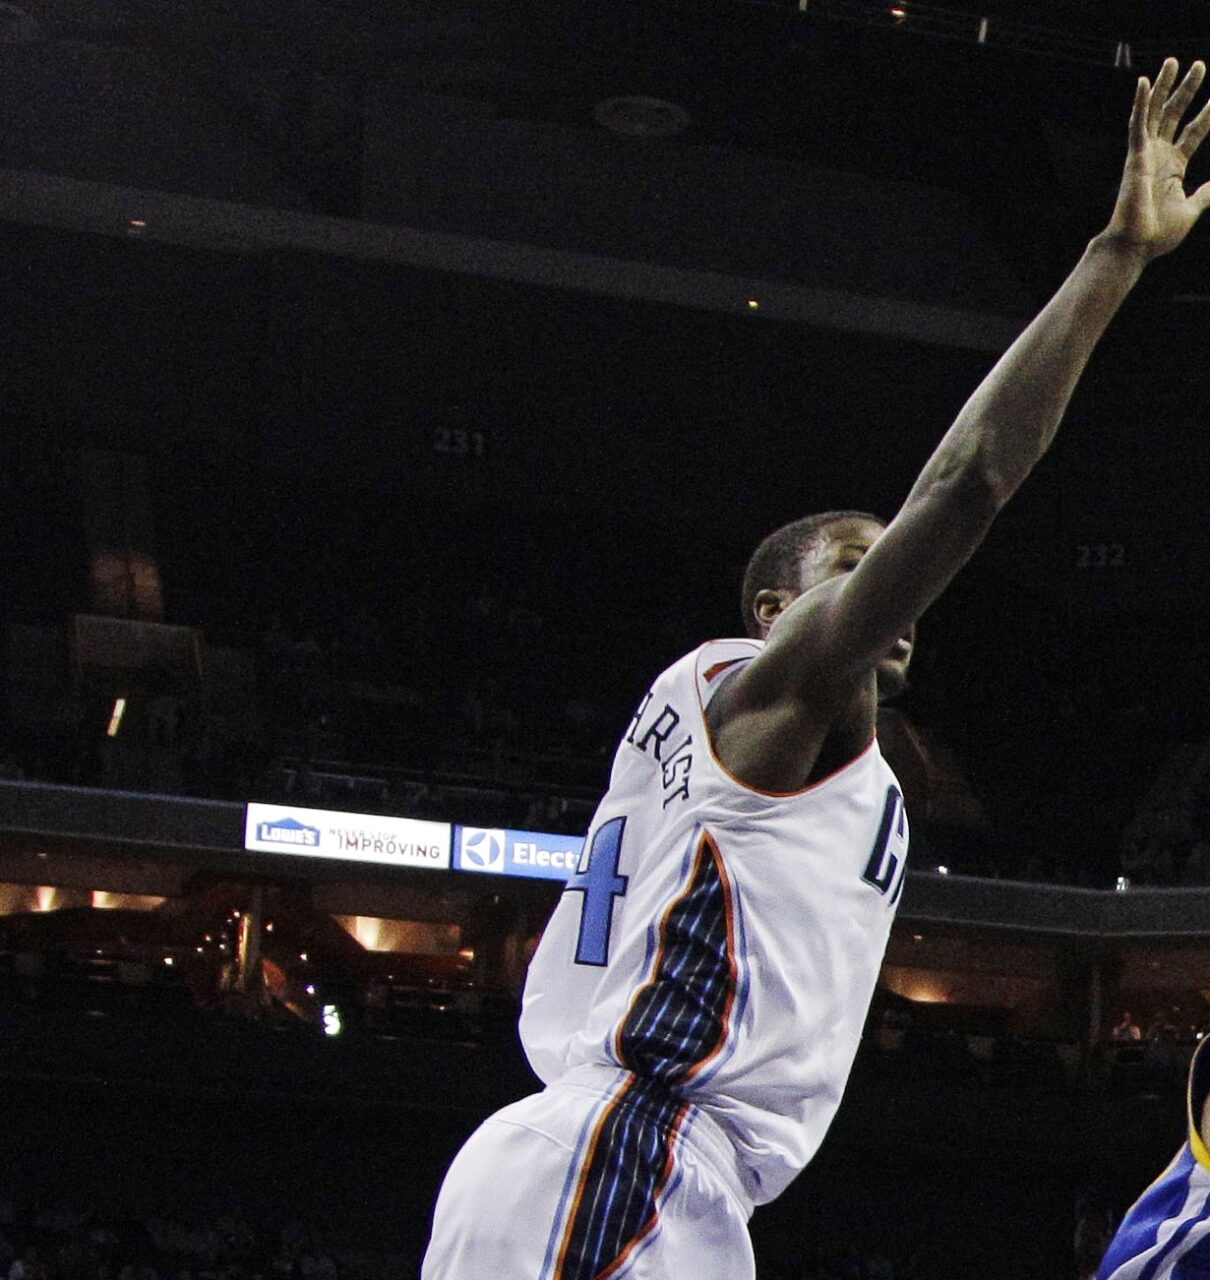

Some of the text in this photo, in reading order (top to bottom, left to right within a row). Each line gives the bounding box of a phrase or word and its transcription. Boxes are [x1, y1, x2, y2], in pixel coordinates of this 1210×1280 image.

[434, 426, 483, 457] 231
[339, 835, 441, 859] IMPROVING
[561, 816, 628, 967] 4
